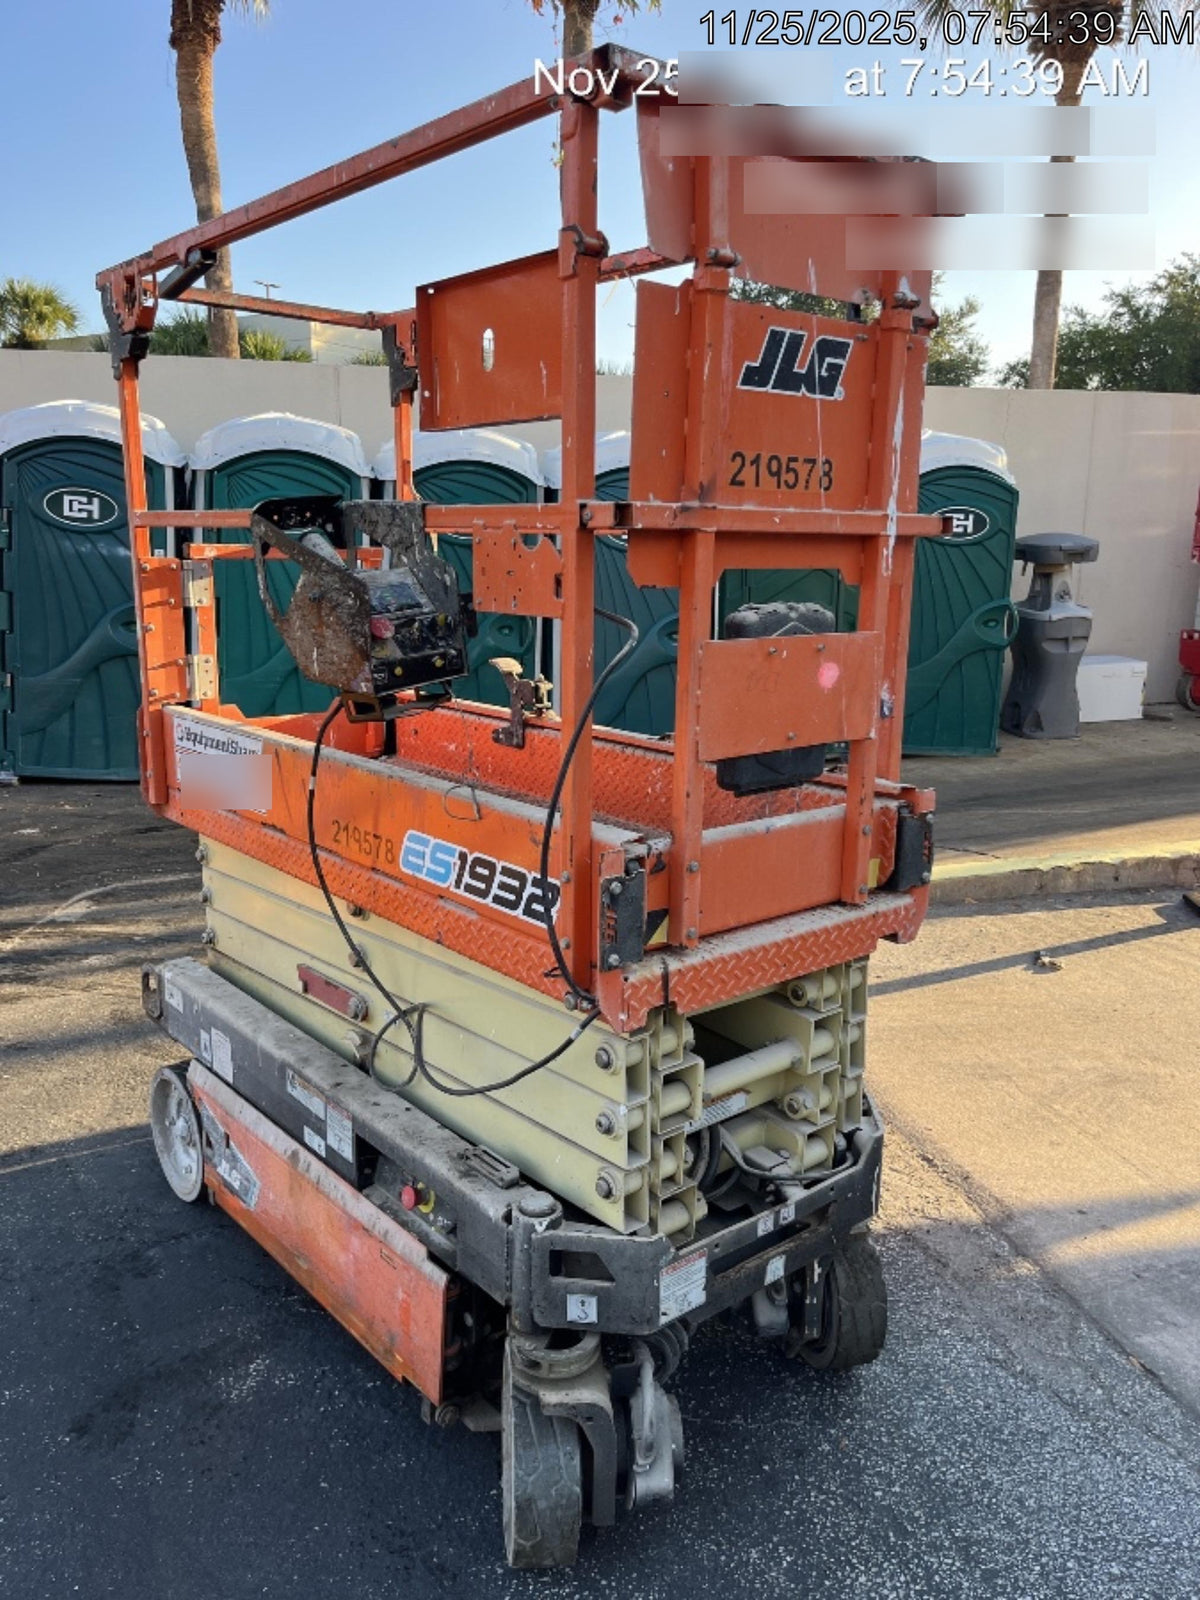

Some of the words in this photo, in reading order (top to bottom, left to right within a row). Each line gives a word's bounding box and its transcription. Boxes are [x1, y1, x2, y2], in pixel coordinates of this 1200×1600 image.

[736, 325, 854, 400] JLG
[728, 451, 833, 491] 219578
[332, 819, 394, 864] 219578
[400, 830, 561, 928] ES1932
